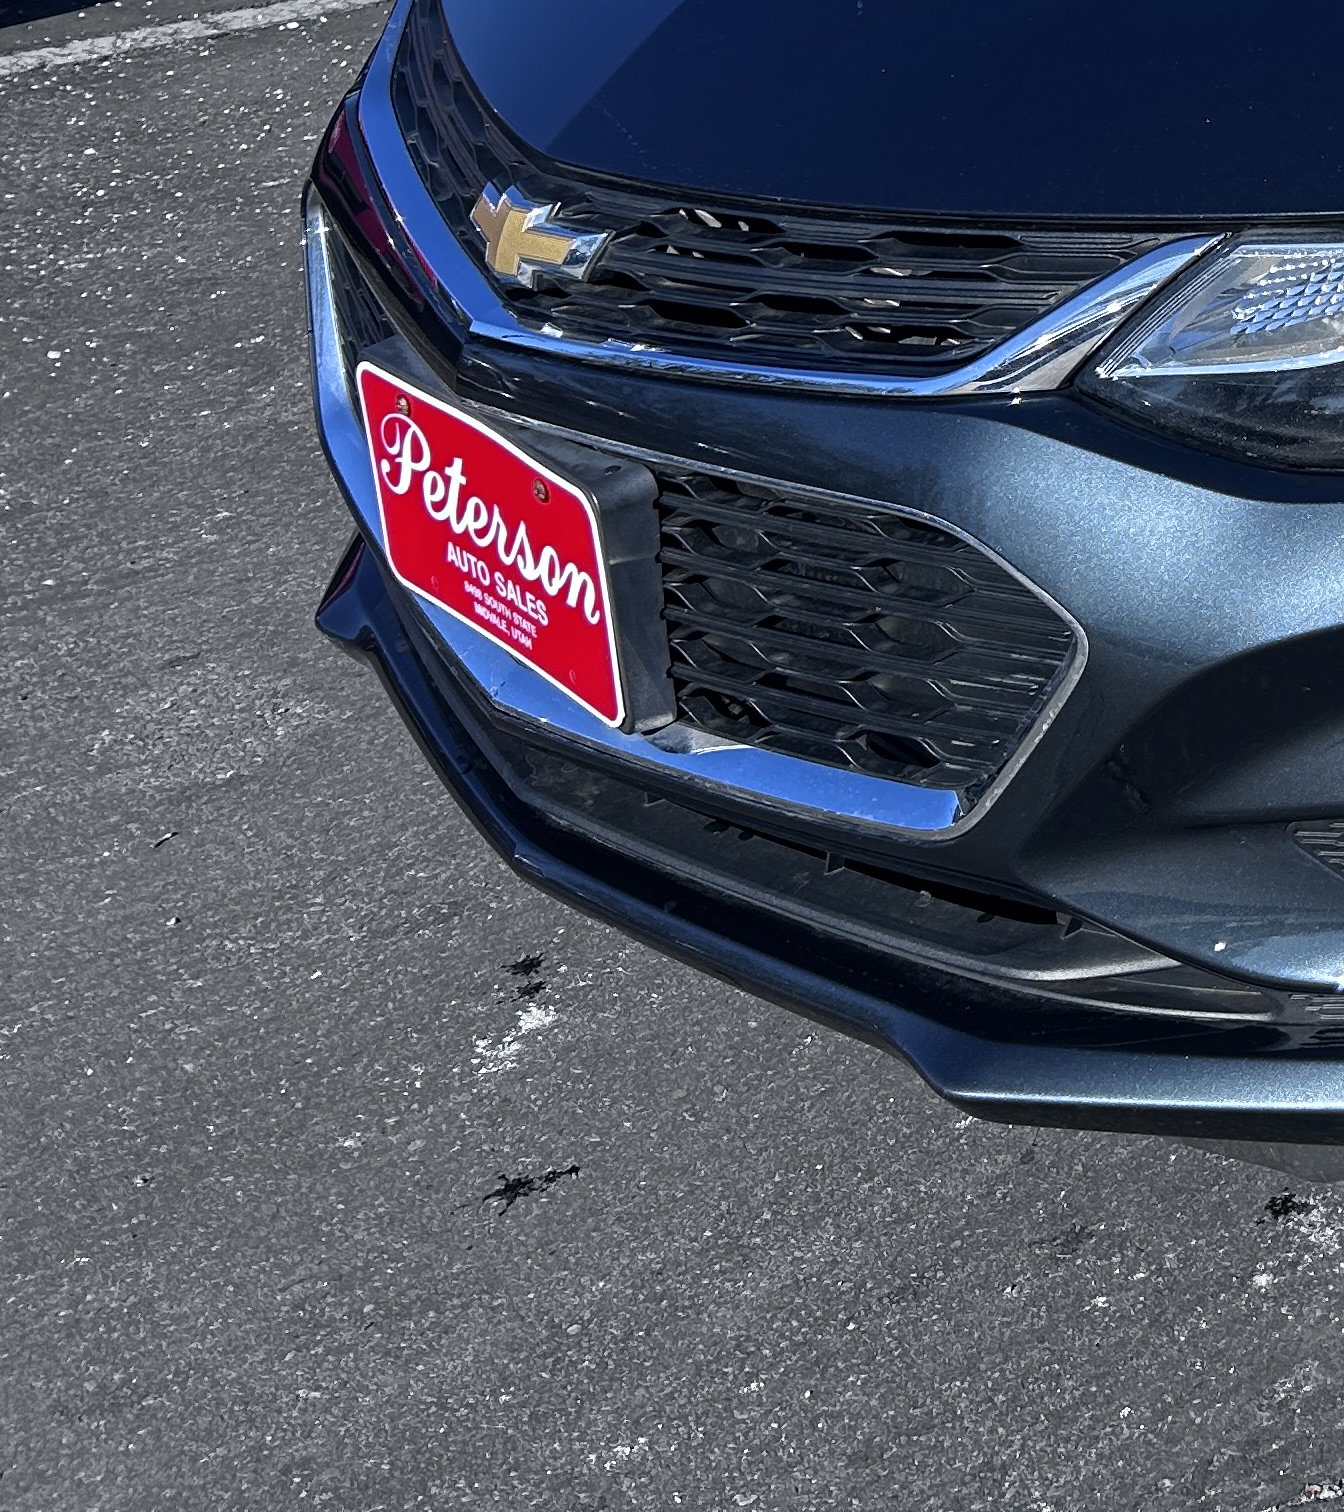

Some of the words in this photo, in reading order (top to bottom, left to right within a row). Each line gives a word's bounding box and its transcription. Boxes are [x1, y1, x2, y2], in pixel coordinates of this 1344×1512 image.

[381, 413, 600, 626] Peterson
[448, 541, 490, 586] AUTO
[494, 571, 549, 626] SALES
[483, 592, 512, 620] SOUTH
[513, 612, 537, 638] STATE
[511, 626, 532, 650] UTAH
